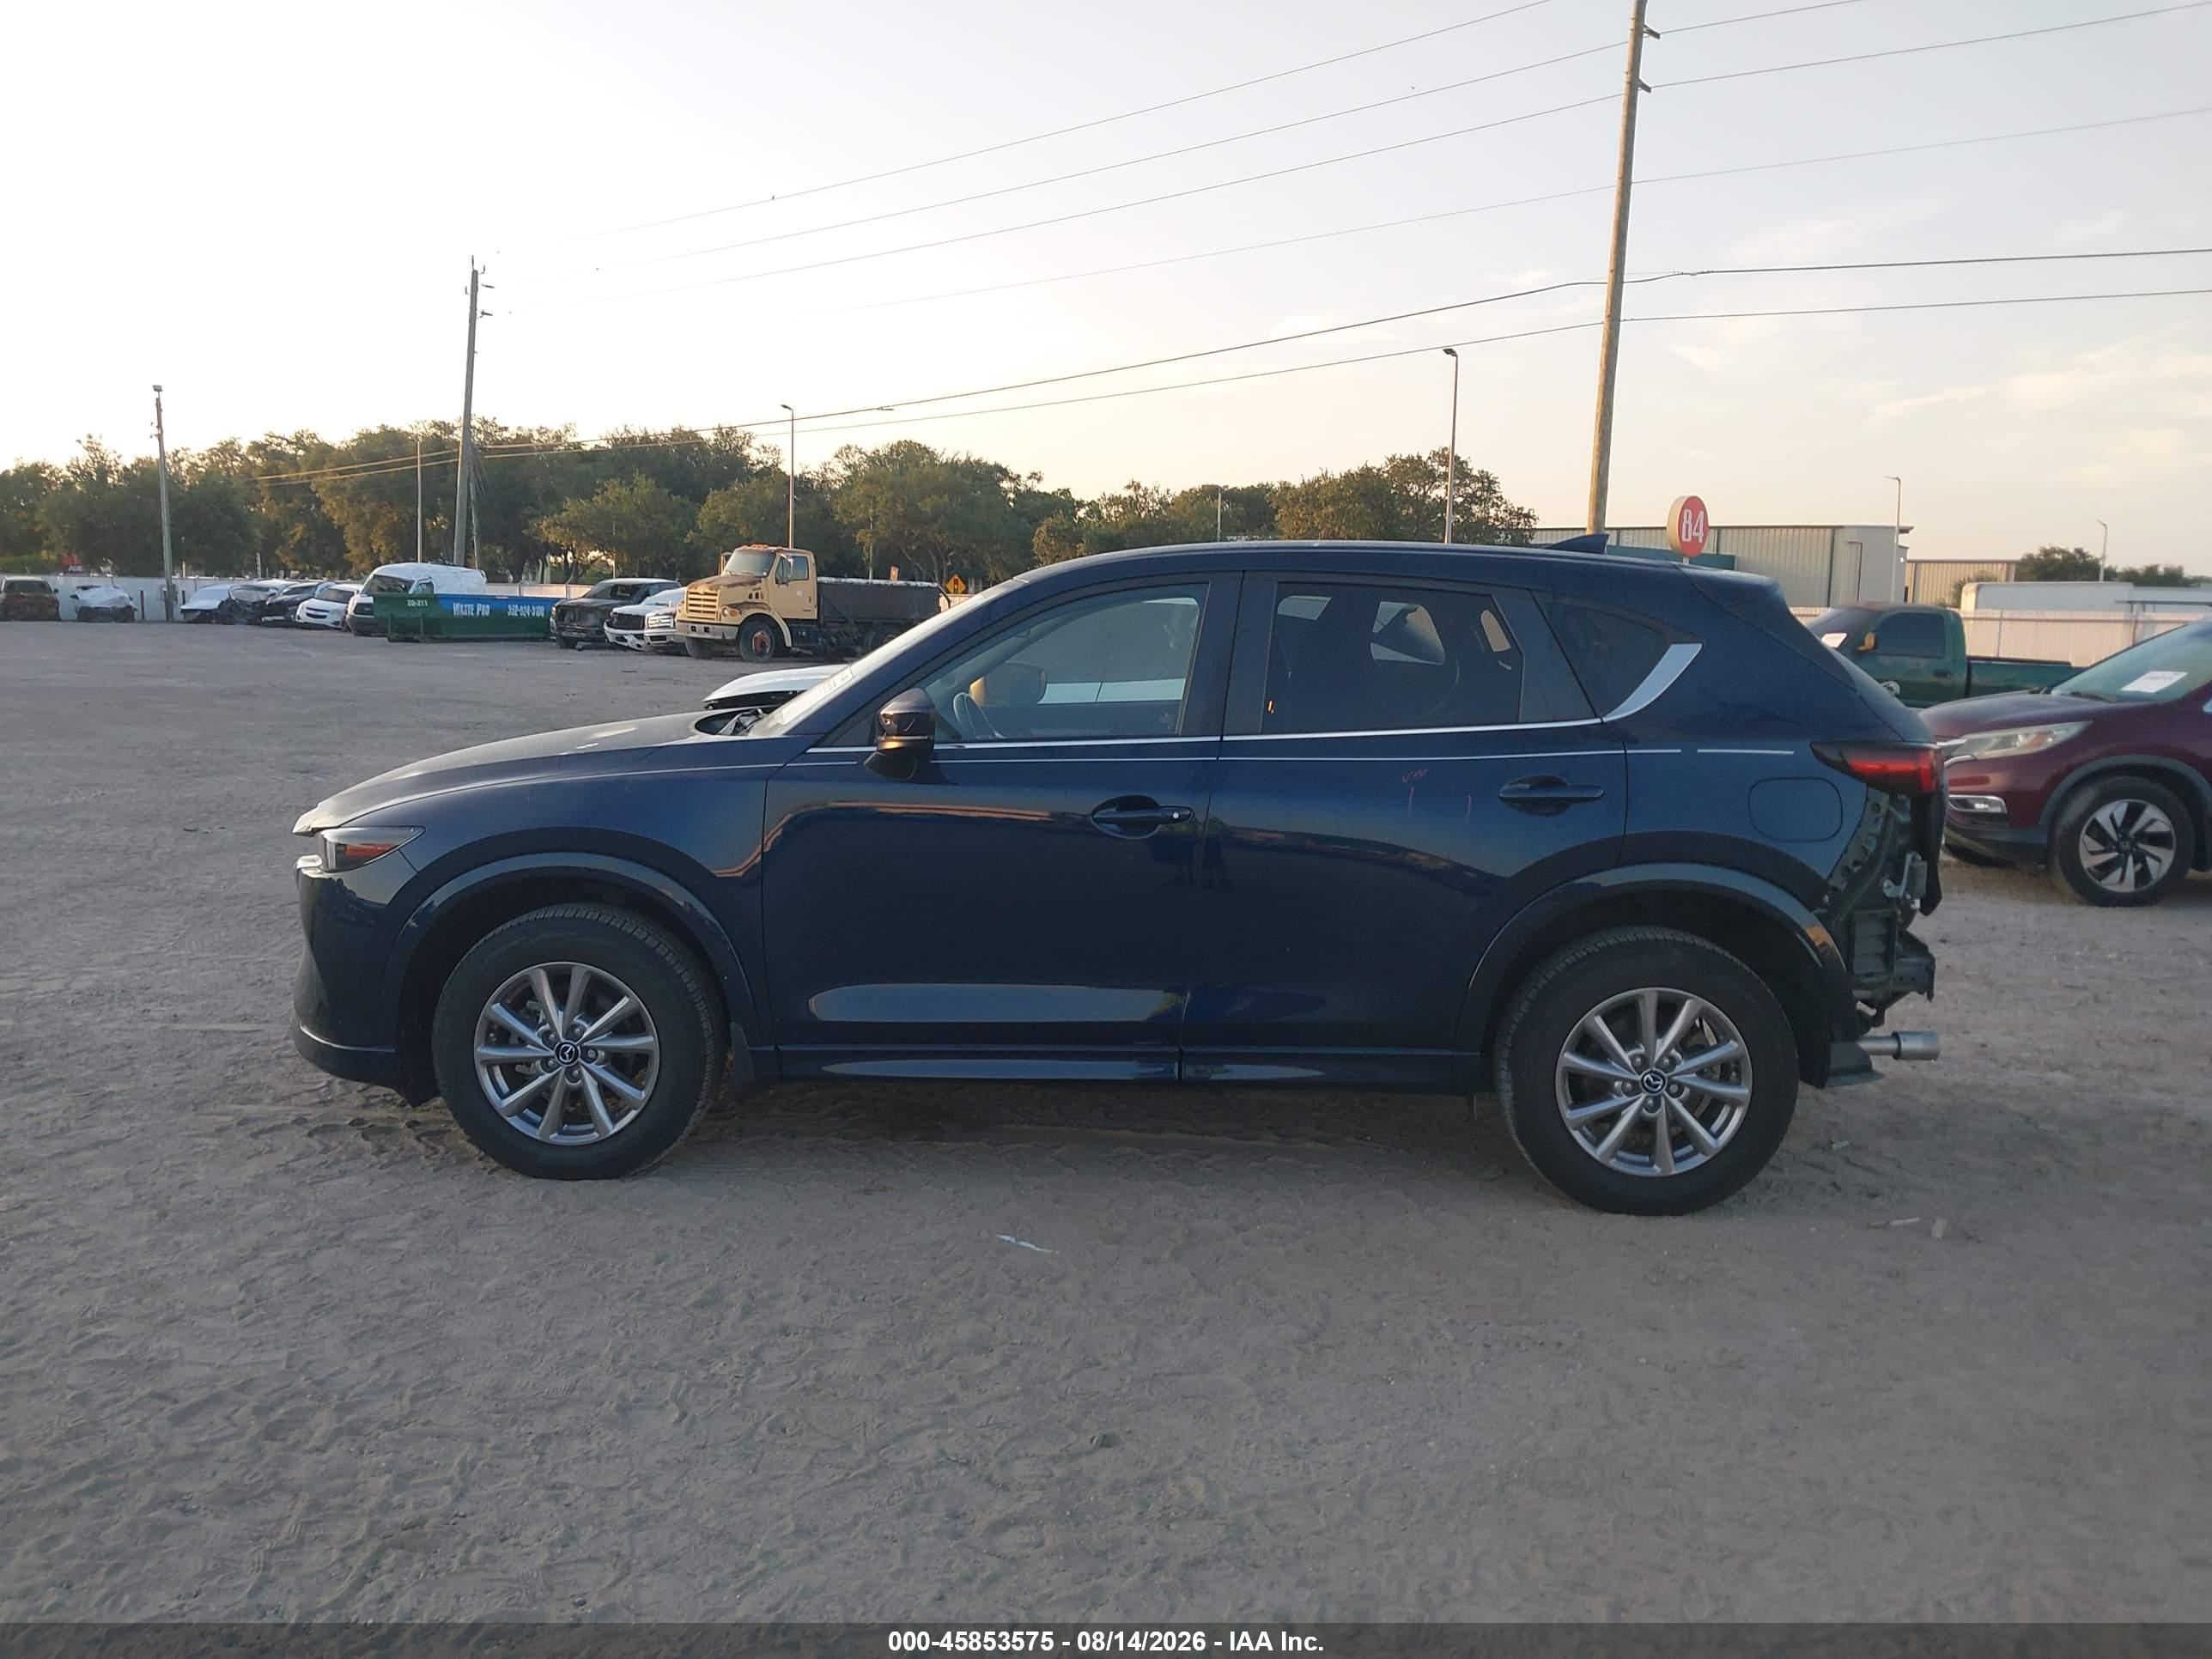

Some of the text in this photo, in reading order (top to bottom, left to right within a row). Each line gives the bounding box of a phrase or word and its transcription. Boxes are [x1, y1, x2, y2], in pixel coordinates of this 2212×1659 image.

[1681, 508, 1705, 544] 84
[453, 602, 490, 617] WASTE PRO
